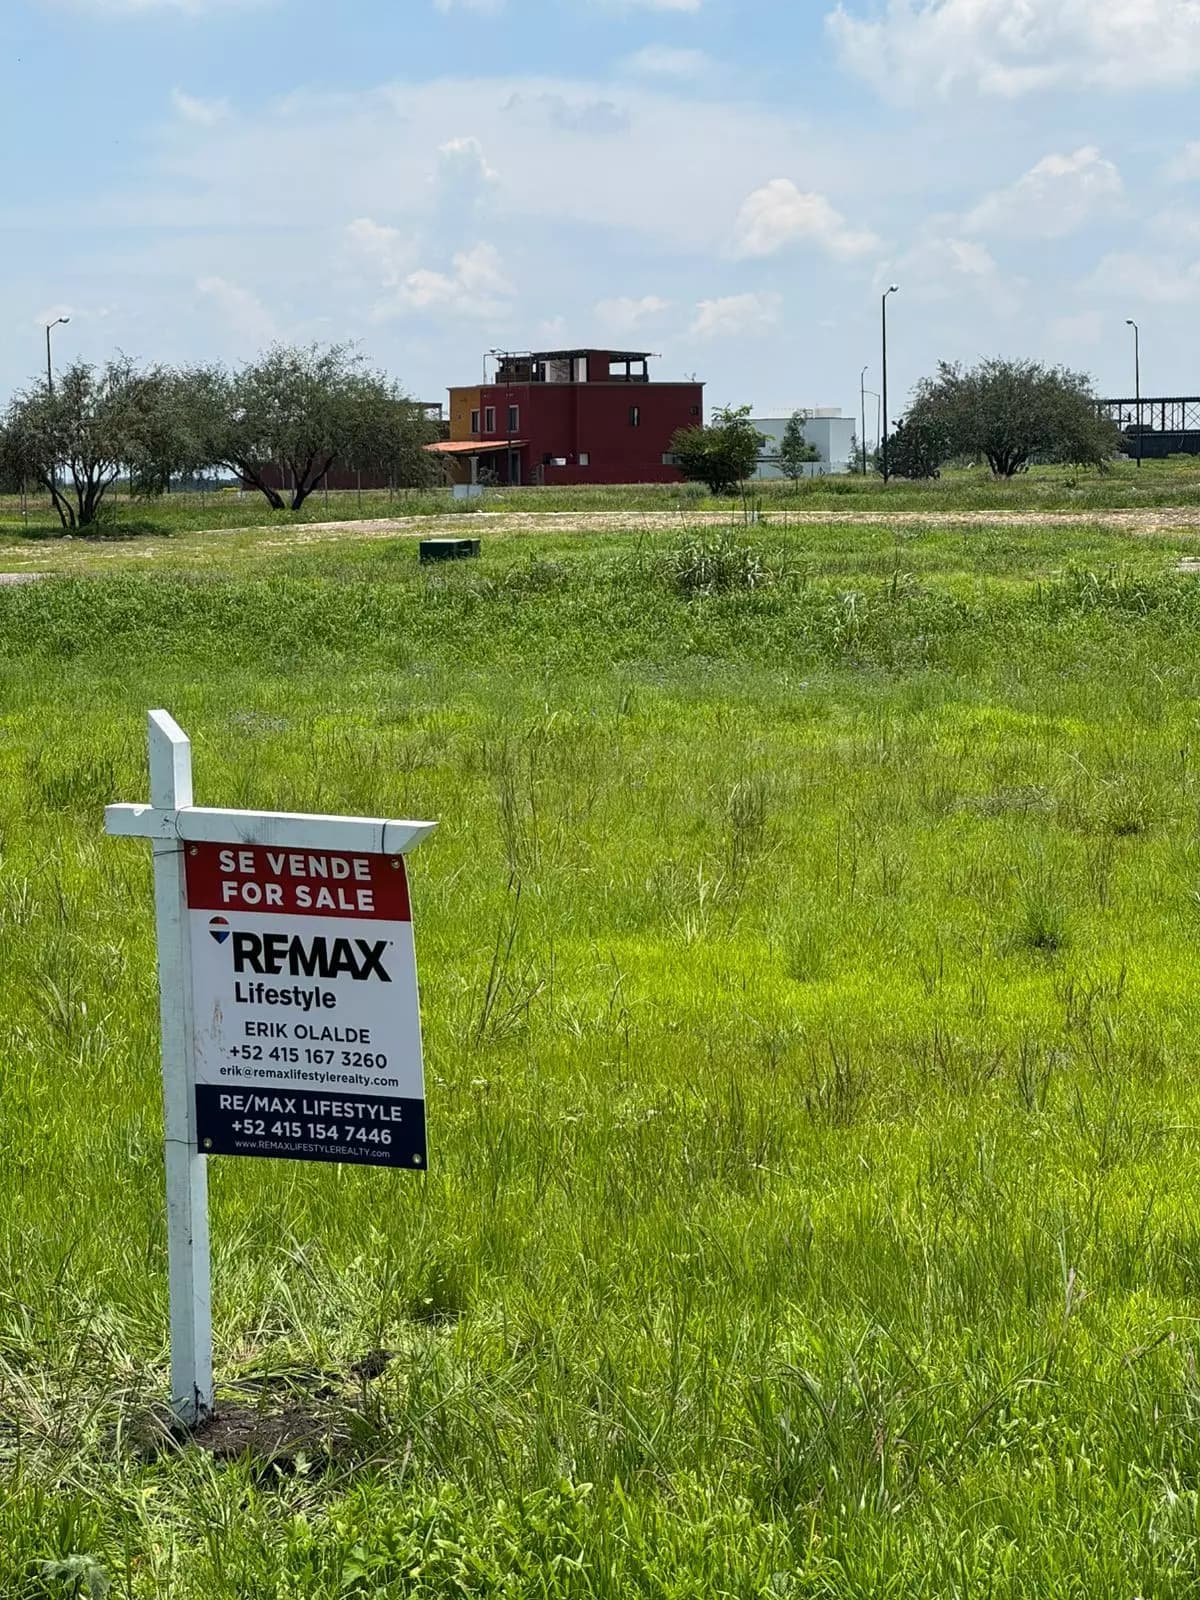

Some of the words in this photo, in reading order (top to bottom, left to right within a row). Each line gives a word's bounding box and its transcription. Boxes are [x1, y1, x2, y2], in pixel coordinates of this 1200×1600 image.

[219, 850, 256, 873] SE
[266, 852, 372, 881] VENDE
[221, 880, 284, 906] FOR
[295, 884, 375, 912] SALE
[235, 981, 336, 1011] Lifestyle
[245, 1021, 288, 1039] ERIK
[294, 1024, 371, 1044] OLALDE
[229, 1045, 263, 1061] +52
[269, 1047, 299, 1063] 415
[305, 1049, 335, 1065] 167
[342, 1052, 388, 1069] 3260
[219, 1066, 399, 1088] erik@remaxlifestylerealty.com
[219, 1094, 297, 1114] RE/MAX
[303, 1099, 402, 1122] LIFESTYLE
[231, 1120, 266, 1136] +52
[271, 1122, 302, 1138] 415
[308, 1124, 339, 1140] 154
[345, 1126, 392, 1145] 7446
